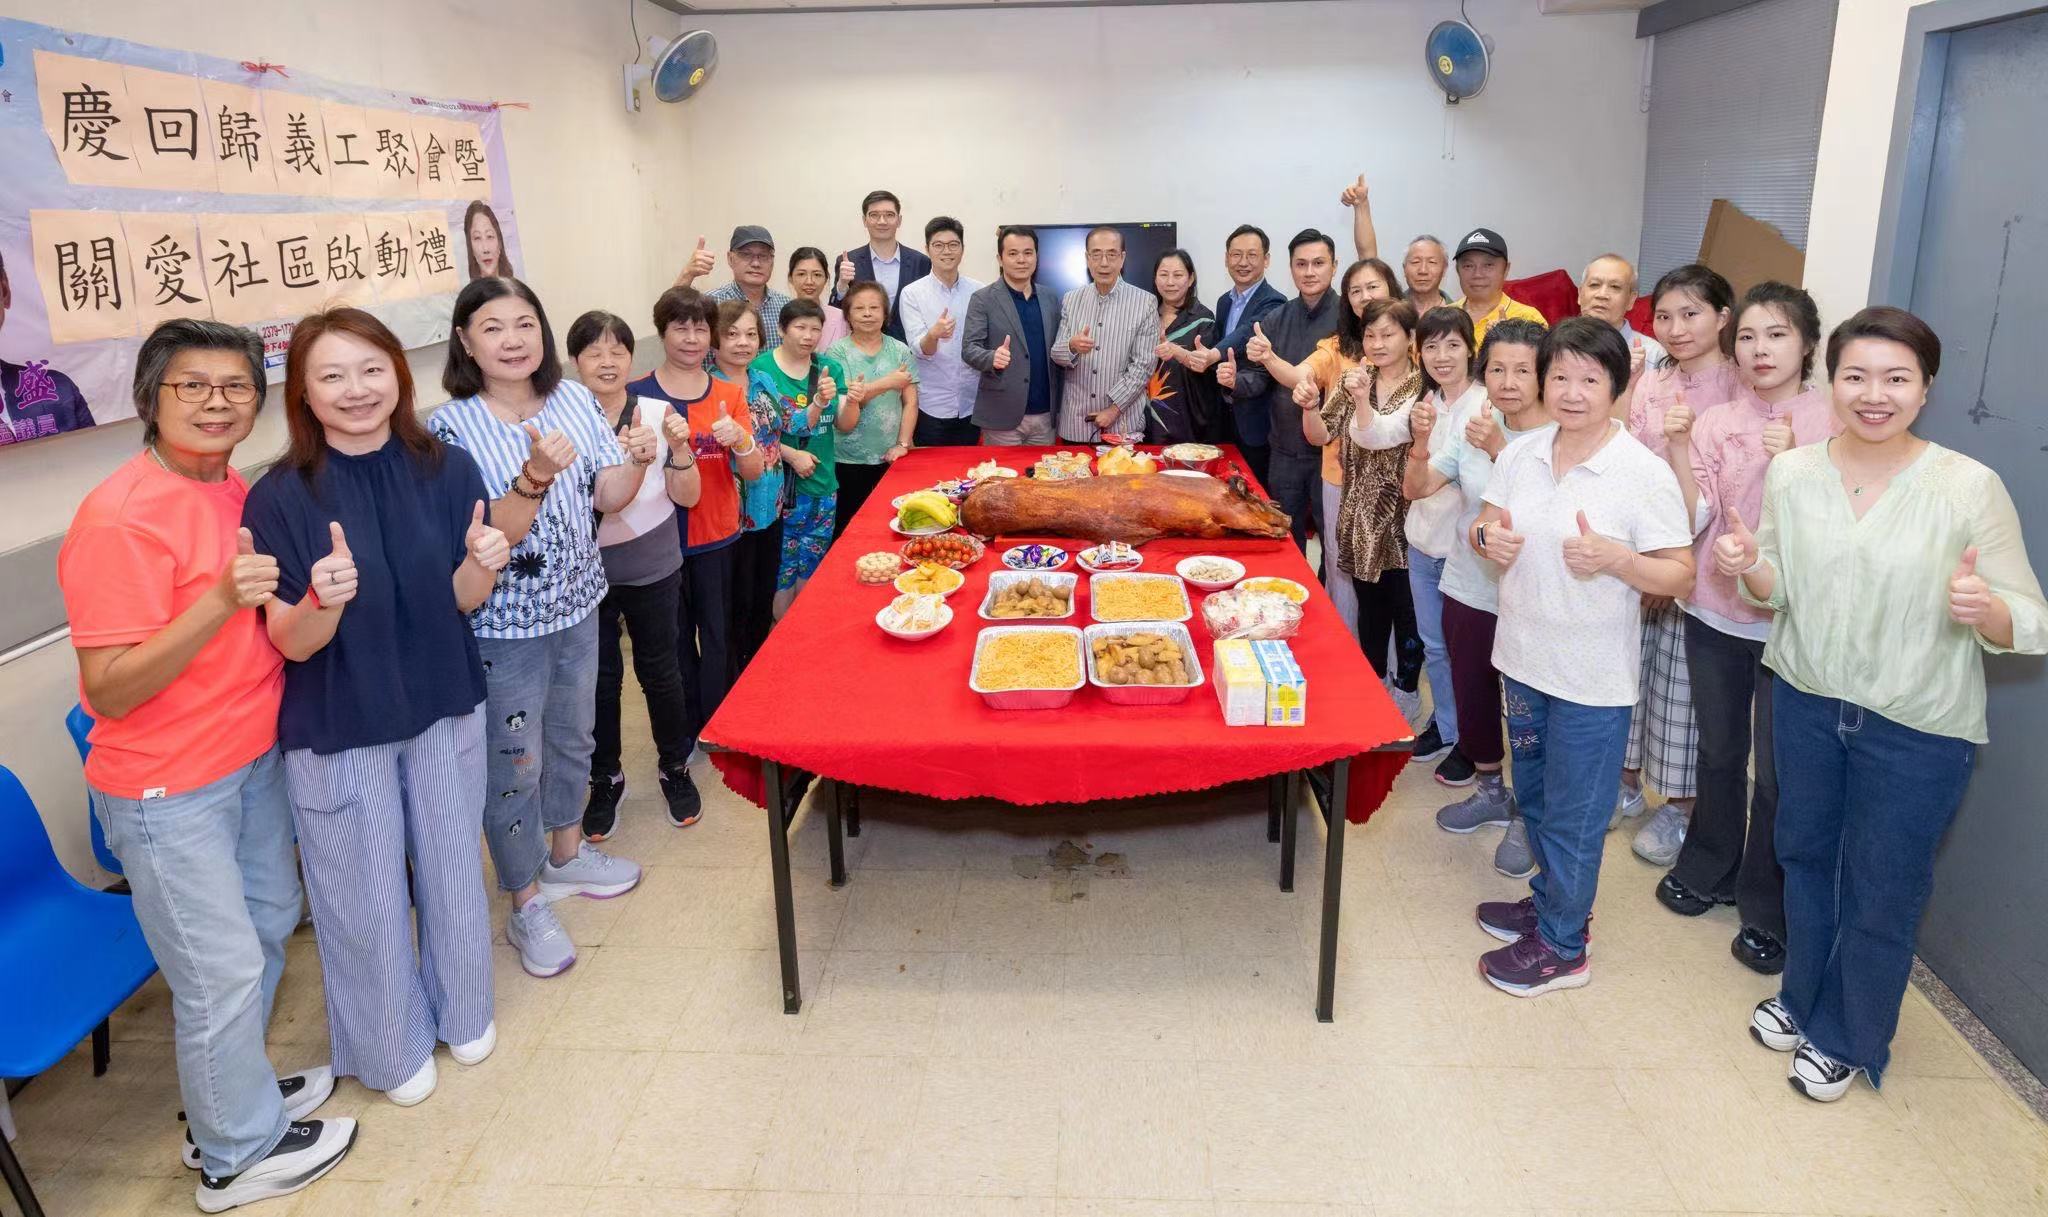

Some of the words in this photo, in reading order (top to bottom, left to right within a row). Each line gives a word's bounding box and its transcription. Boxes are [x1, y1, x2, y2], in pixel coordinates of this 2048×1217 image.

[63, 82, 486, 183] 慶回歸義工聚會暨
[54, 227, 455, 312] 關愛社區啟動禮
